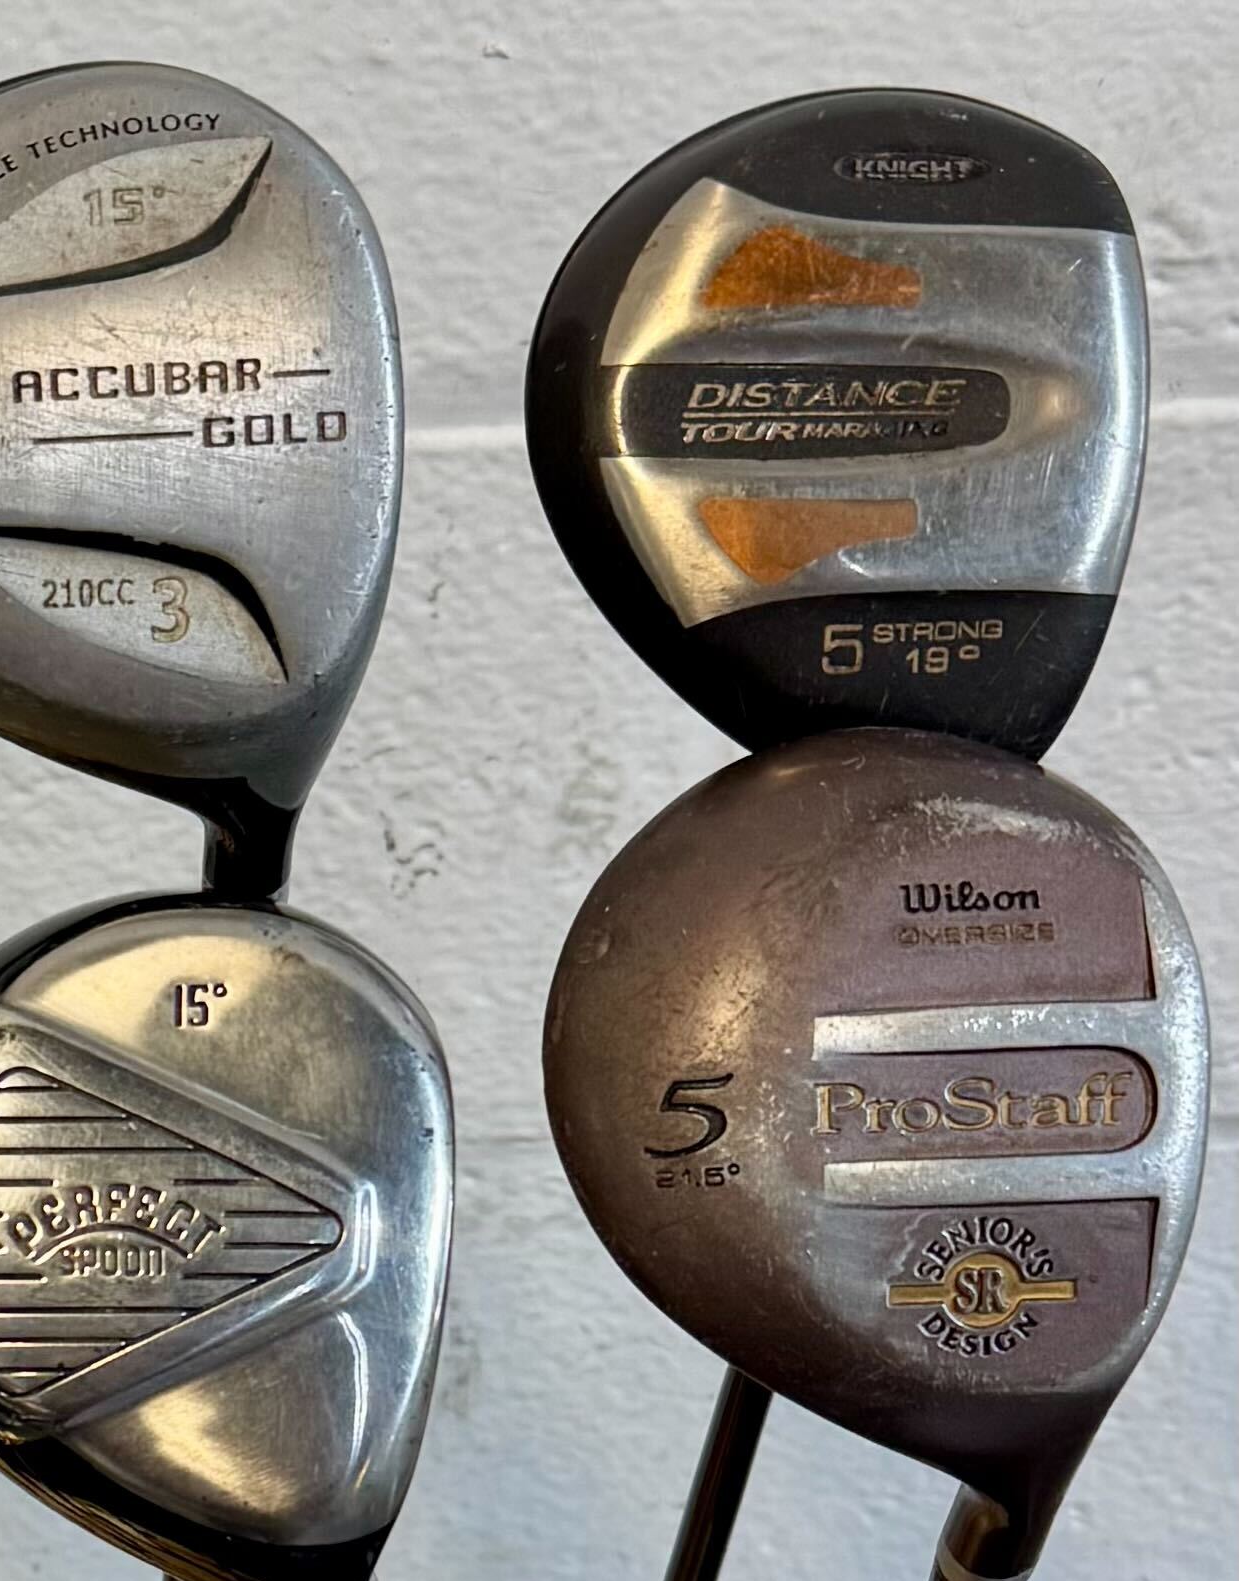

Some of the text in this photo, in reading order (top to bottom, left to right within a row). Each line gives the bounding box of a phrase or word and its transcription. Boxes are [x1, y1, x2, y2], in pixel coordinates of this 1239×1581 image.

[26, 112, 221, 159] TECHNOLOGY
[854, 157, 972, 181] KNIGHT
[12, 358, 262, 403] ACCUBAR
[687, 378, 967, 410] DISTANCE
[202, 410, 348, 449] GOLD
[681, 421, 796, 444] TOUR
[42, 576, 190, 643] 210CC 3
[821, 619, 1003, 675] 5 STRONG
[899, 880, 1041, 914] Wilson
[898, 921, 1055, 945] OVERSIZE
[173, 975, 228, 1028] 15°
[643, 1072, 735, 1159] 5
[7, 1184, 227, 1262] PERFECT
[914, 1214, 1055, 1283] SENIOR'S
[951, 1266, 1012, 1315] SR
[917, 1311, 1040, 1358] DESIGN
